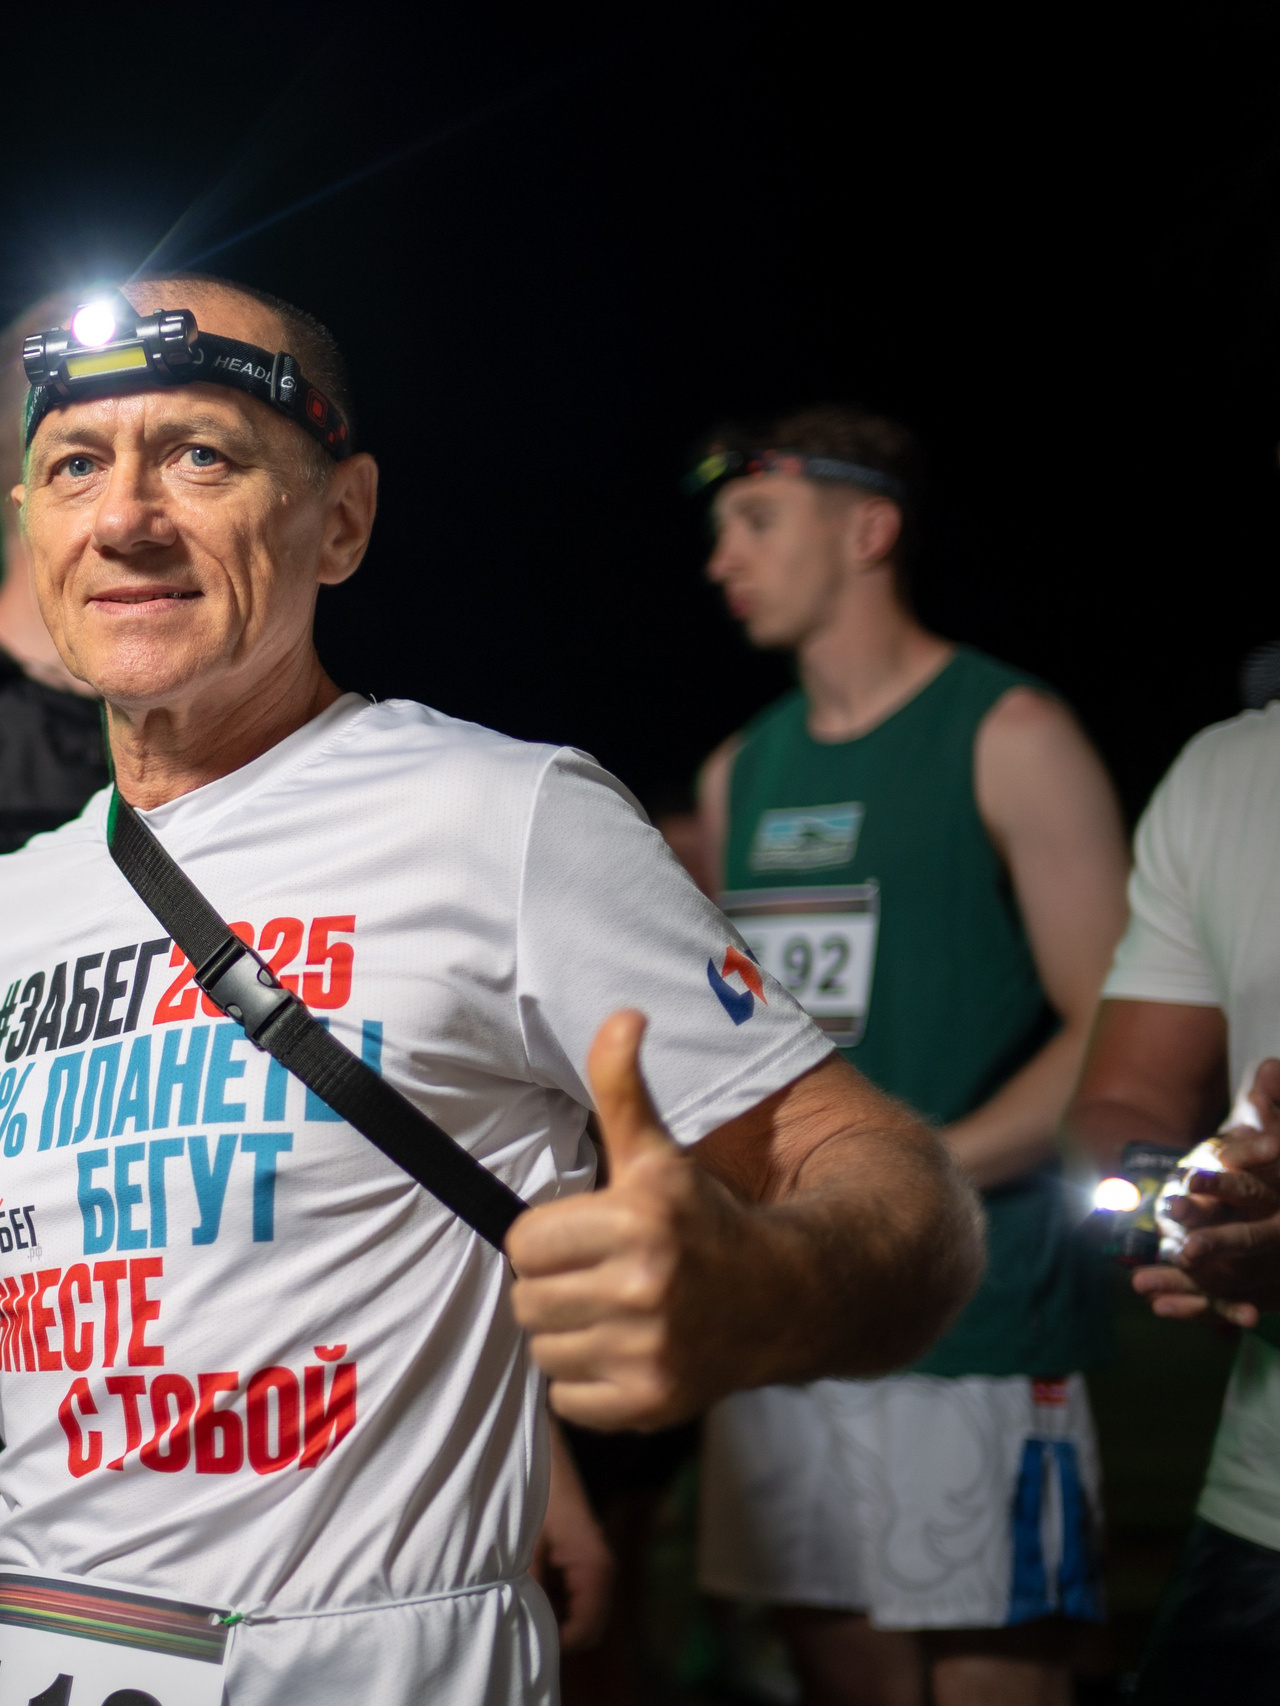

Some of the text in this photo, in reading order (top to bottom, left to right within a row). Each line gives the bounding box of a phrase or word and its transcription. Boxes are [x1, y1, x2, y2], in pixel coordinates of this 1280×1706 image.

[783, 934, 851, 996] 92
[77, 1132, 294, 1255] БЕГУТ
[58, 1344, 357, 1478] С ТОБОЙ
